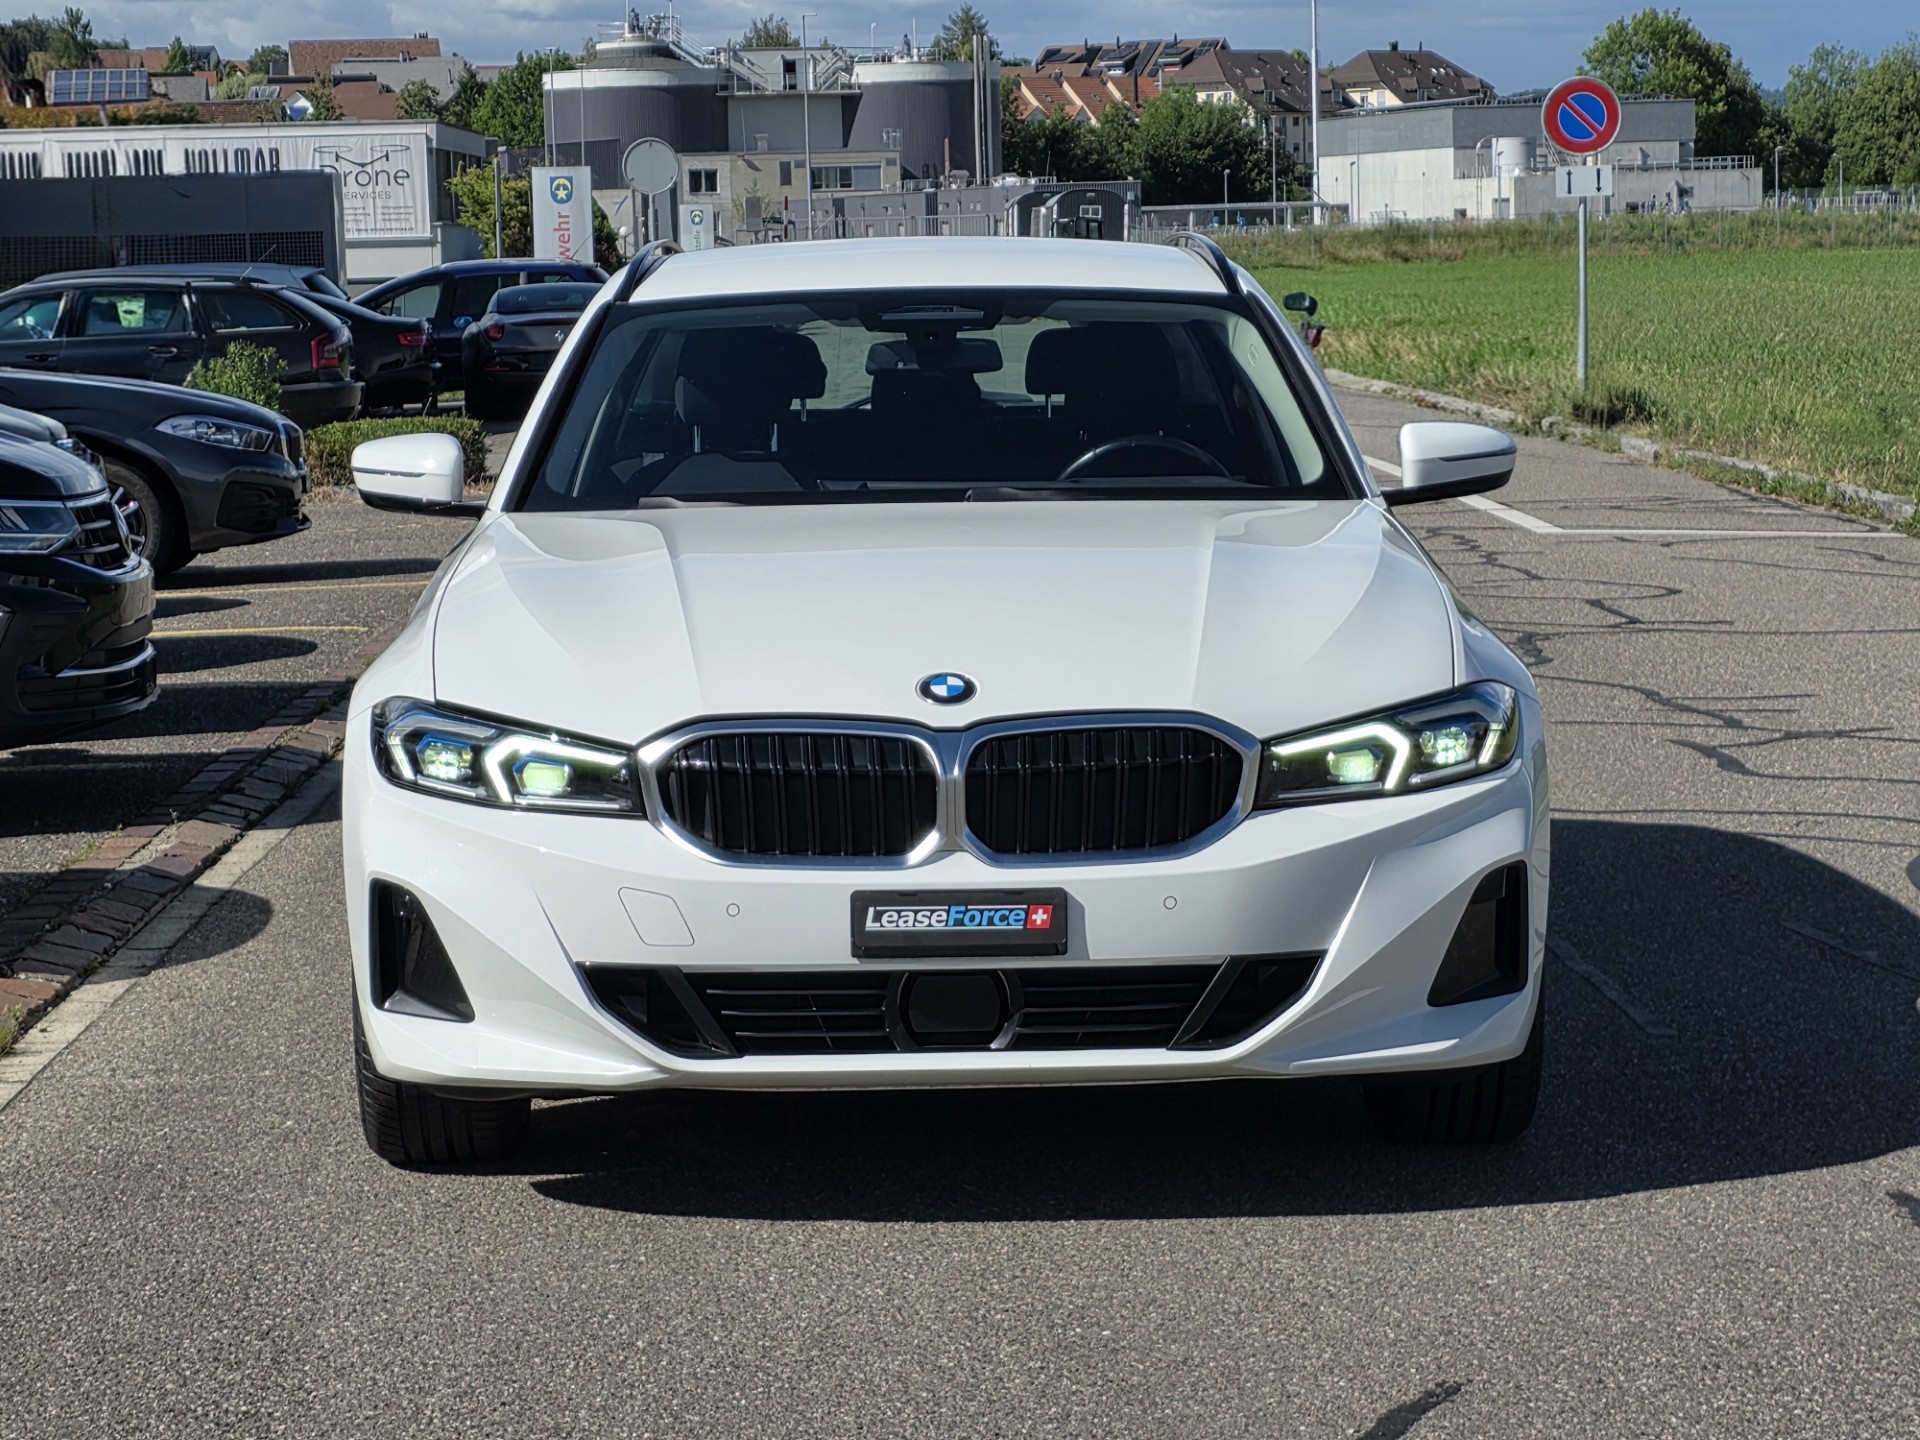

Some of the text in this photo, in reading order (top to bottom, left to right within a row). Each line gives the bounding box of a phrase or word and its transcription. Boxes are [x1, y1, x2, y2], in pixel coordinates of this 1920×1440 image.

[320, 165, 410, 187] rone
[344, 191, 391, 200] ERVICES
[865, 905, 1026, 928] LeaseForce
